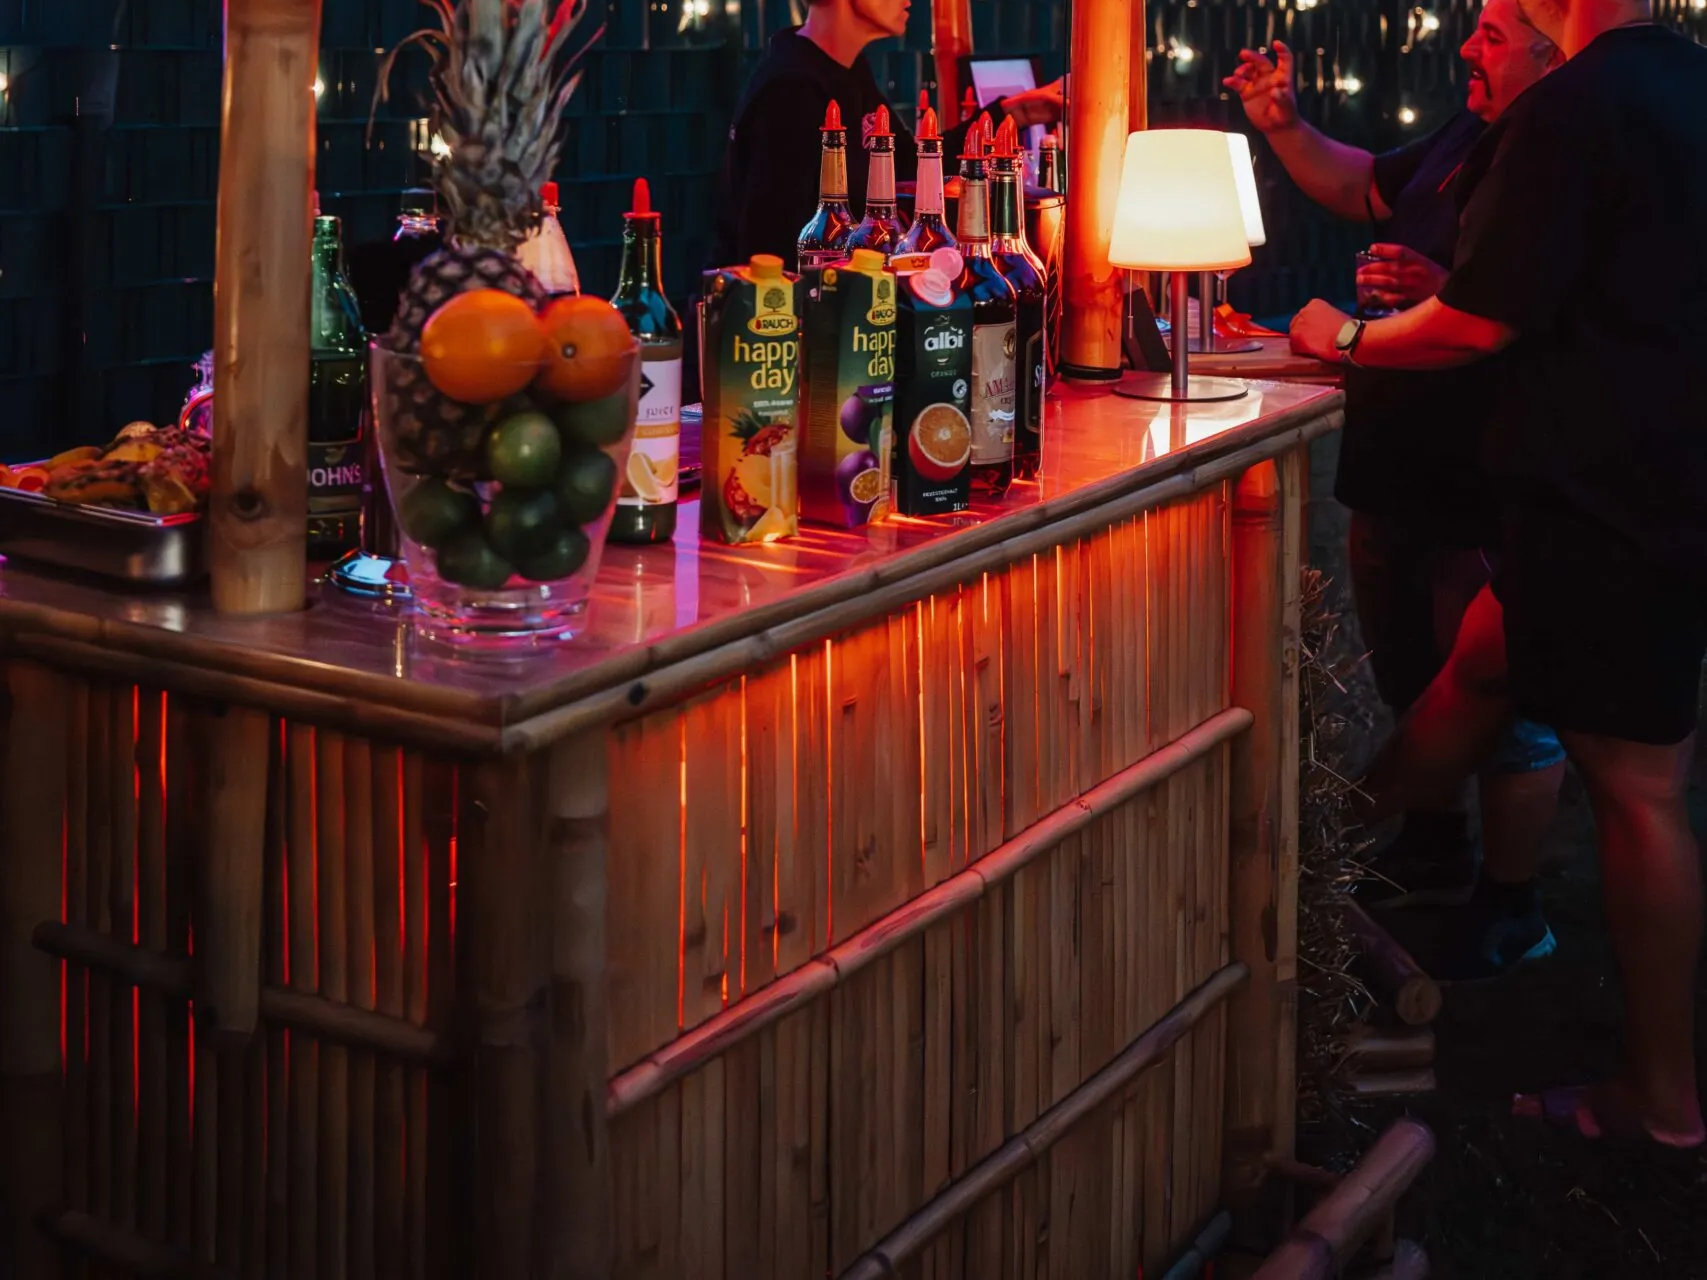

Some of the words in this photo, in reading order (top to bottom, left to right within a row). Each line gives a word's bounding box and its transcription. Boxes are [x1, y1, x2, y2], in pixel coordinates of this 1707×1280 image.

[762, 318, 794, 329] RAUCH
[852, 326, 896, 356] happ
[924, 328, 963, 351] albi
[751, 362, 796, 395] day
